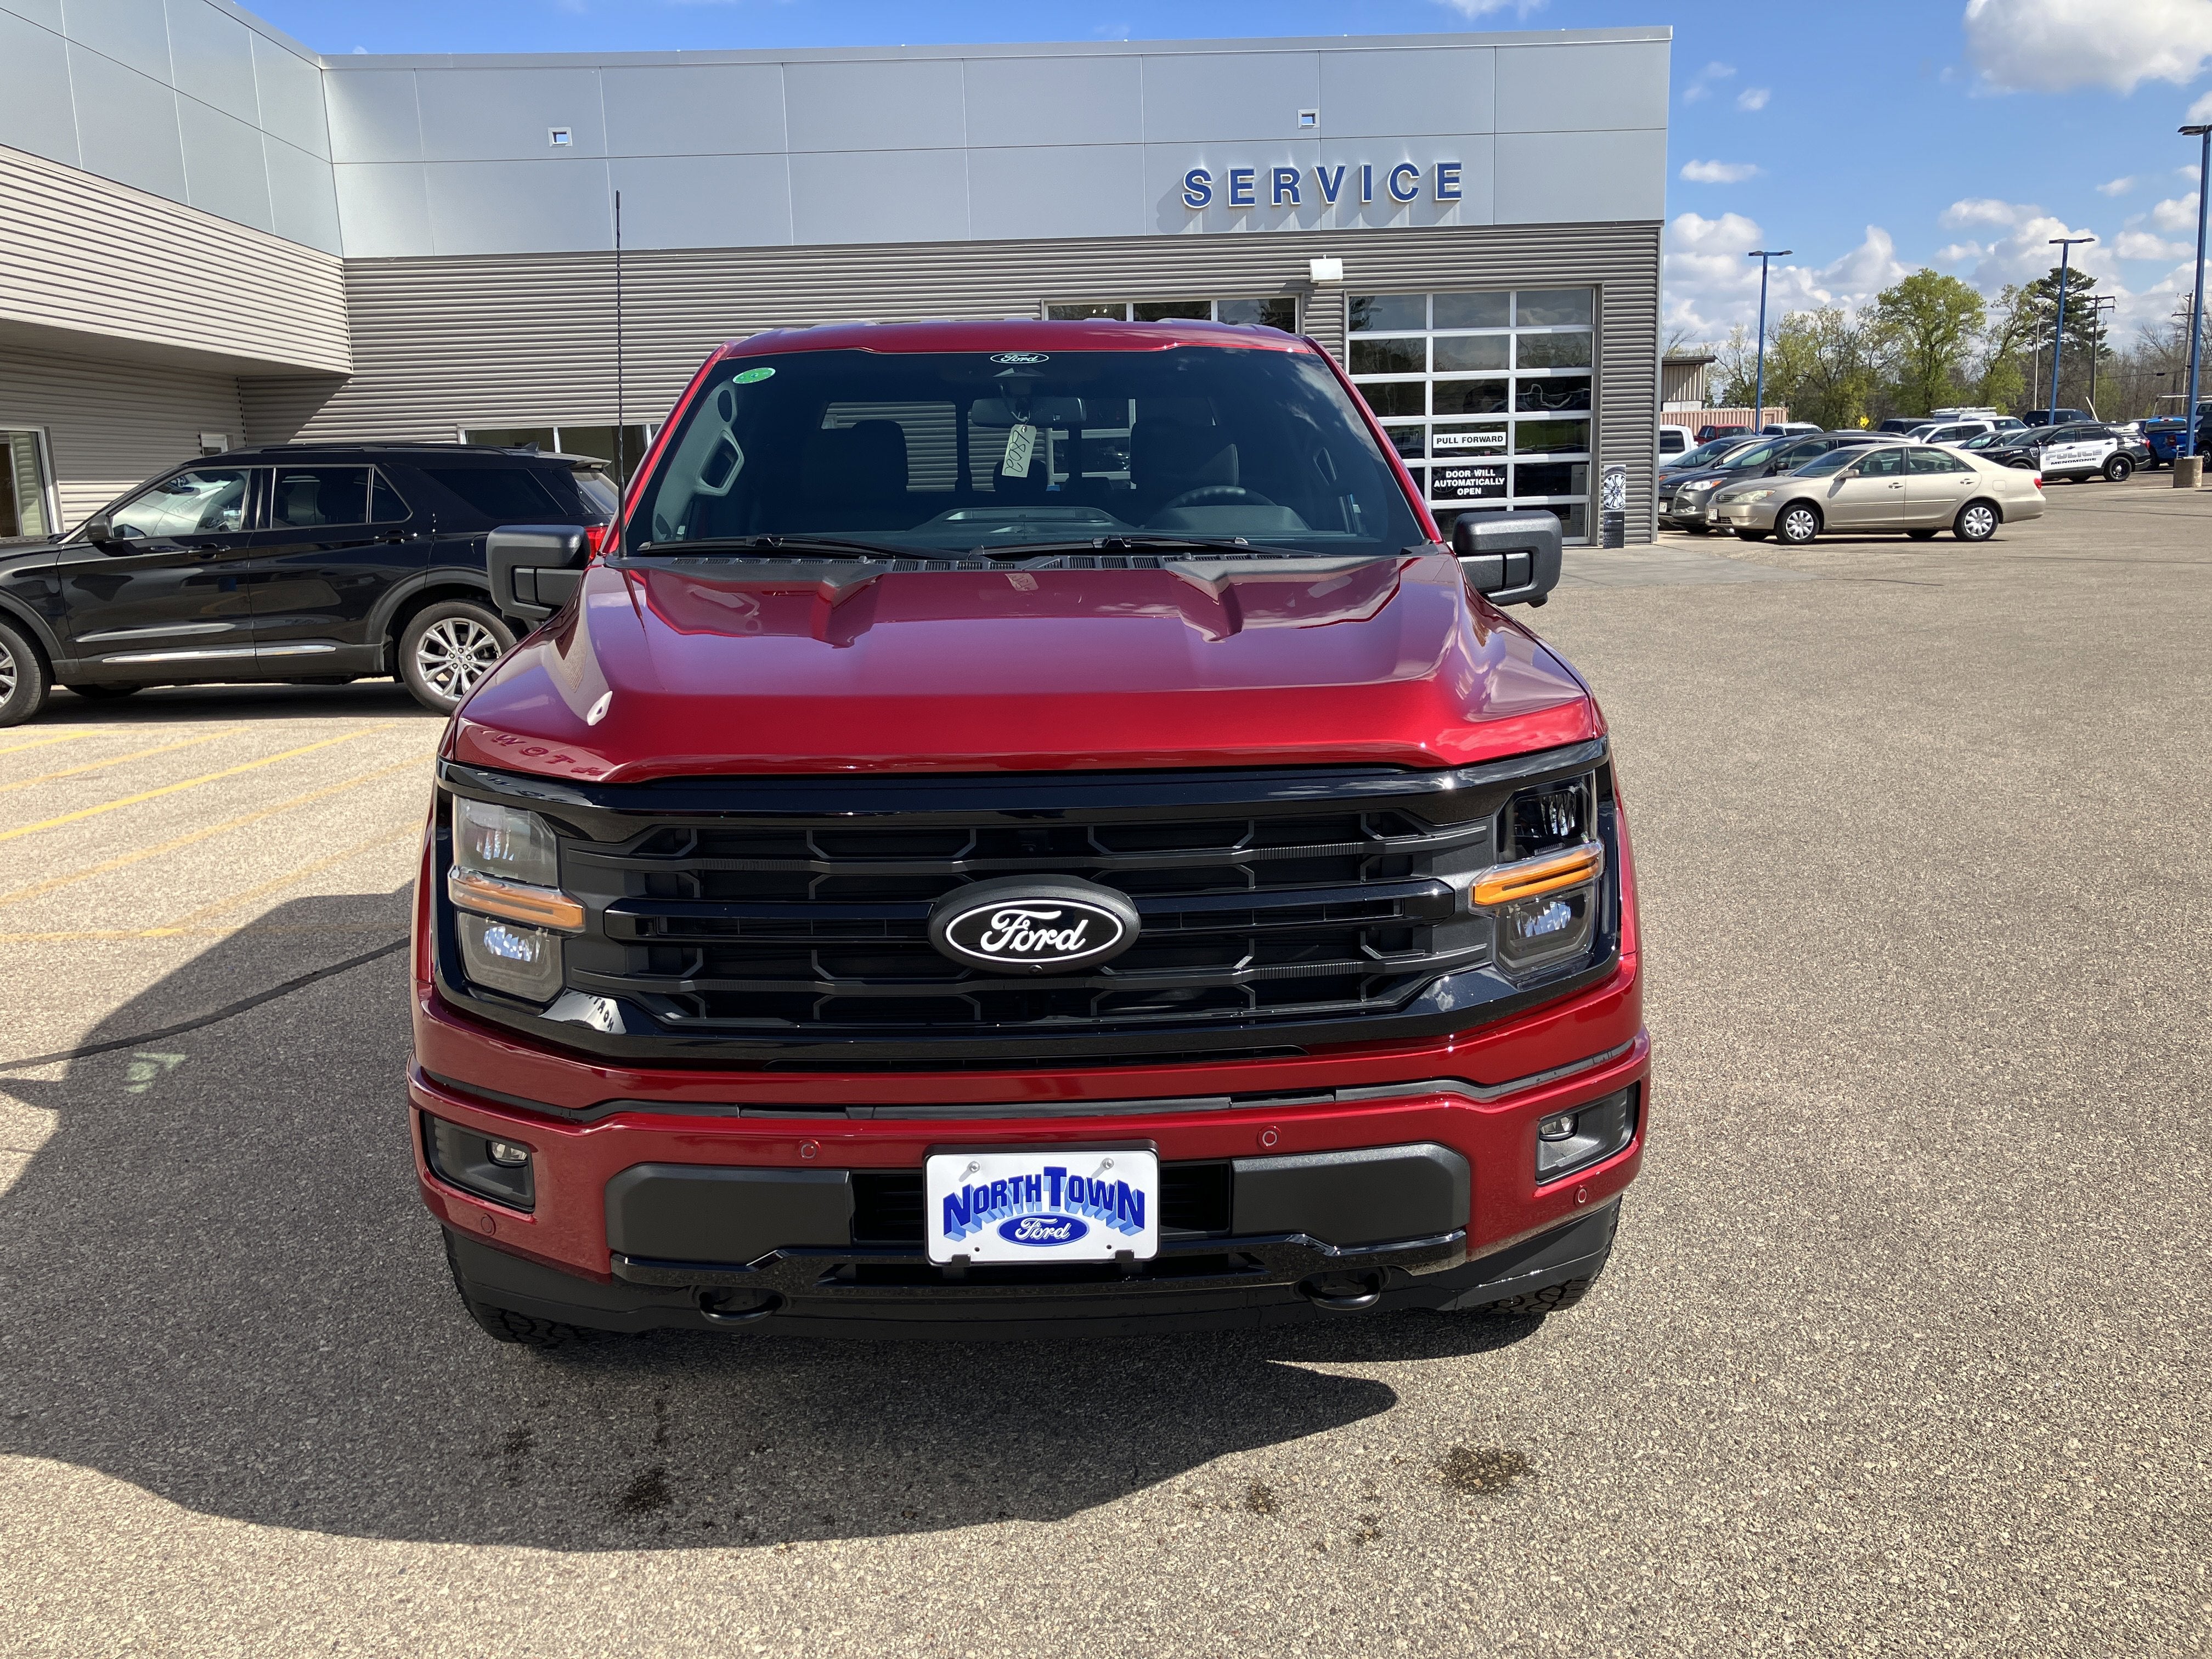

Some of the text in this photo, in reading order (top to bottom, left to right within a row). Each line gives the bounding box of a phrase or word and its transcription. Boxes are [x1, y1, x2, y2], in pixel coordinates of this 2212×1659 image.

[1182, 162, 1463, 208] SERVICE
[1000, 354, 1039, 362] Ford
[1462, 436, 1504, 444] FORWARD
[2045, 449, 2102, 461] POLICE
[1434, 477, 1505, 488] AUTOMATICALLY
[1457, 487, 1482, 495] OPEN
[980, 909, 1088, 952] Ford
[1014, 1217, 1071, 1240] Ford
